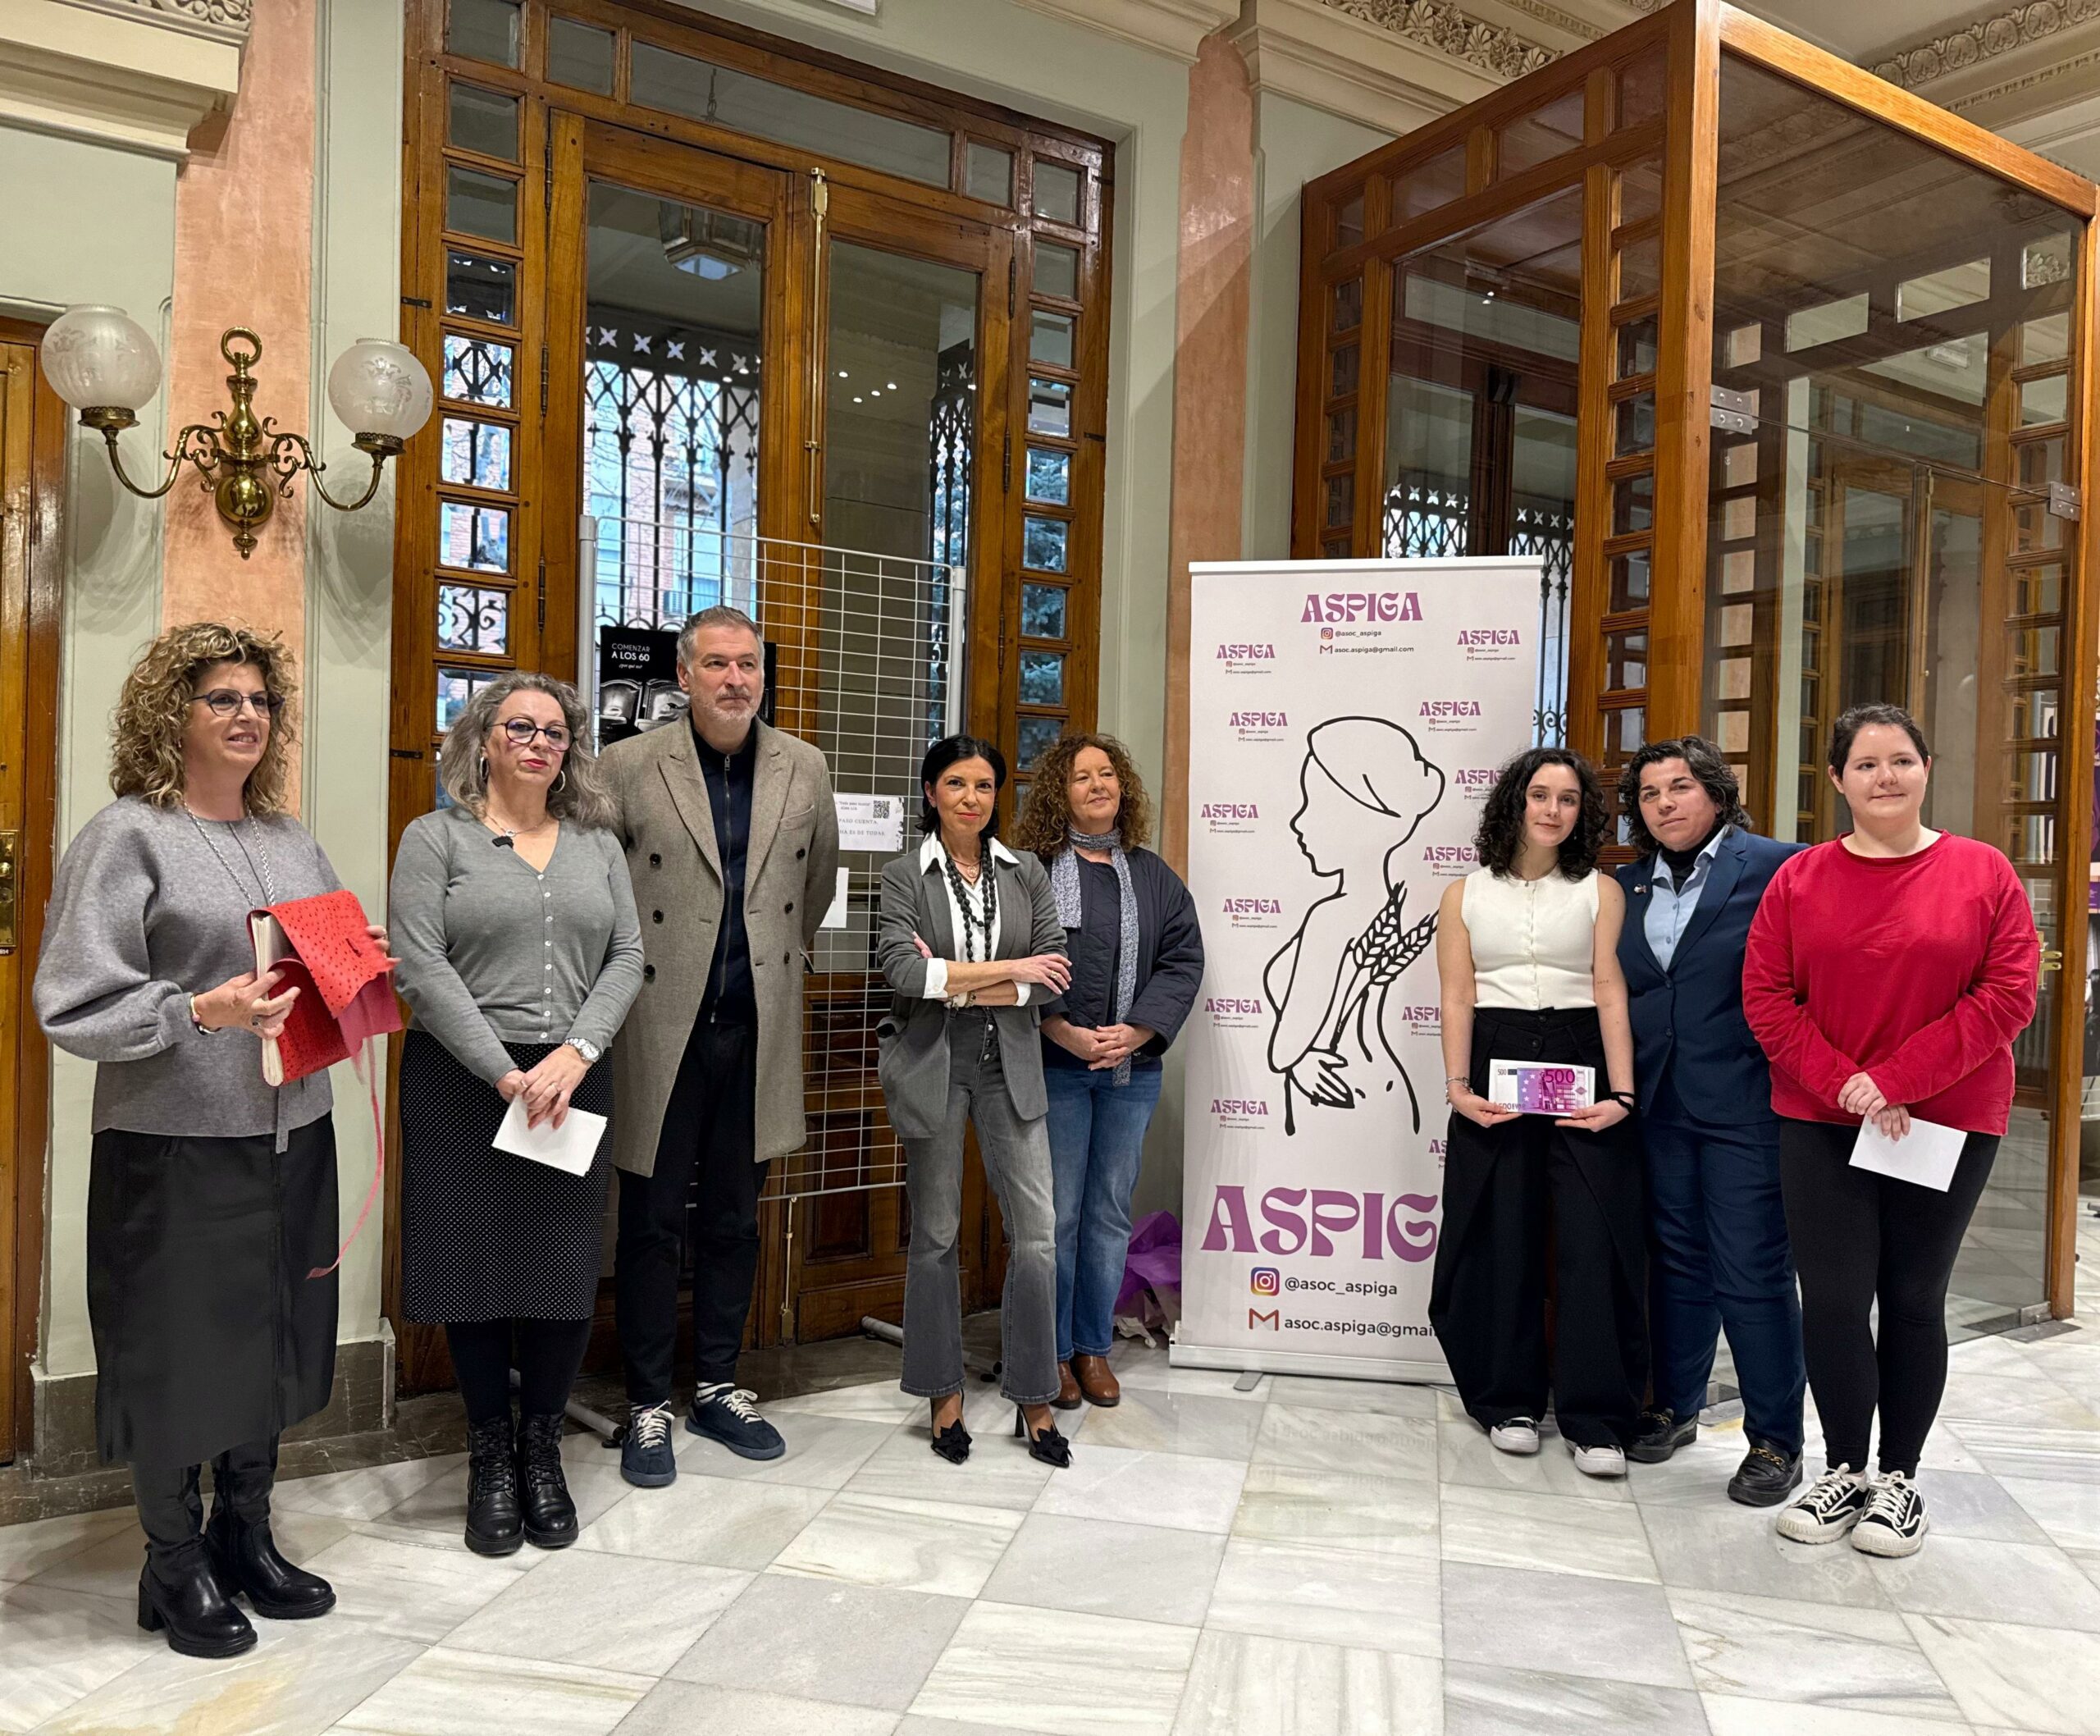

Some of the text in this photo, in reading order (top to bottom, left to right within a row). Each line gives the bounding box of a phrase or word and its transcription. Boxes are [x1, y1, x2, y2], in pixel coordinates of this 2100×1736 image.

[1300, 592, 1423, 623] ASPIGA
[1335, 630, 1381, 638] @asoc_aspiga
[1457, 629, 1521, 646] ASPIGA
[611, 643, 651, 652] COMENZAR
[1217, 644, 1276, 659] ASPIGA
[1335, 646, 1414, 654] asoc.aspiga@gmail.com
[611, 651, 651, 661] A LOS 60
[1418, 701, 1481, 716] ASPIGA
[1229, 712, 1289, 727] ASPIGA
[1201, 804, 1259, 819] ASPIGA
[1223, 898, 1281, 914] ASPIGA
[1204, 998, 1262, 1014] ASPIGA
[1401, 1007, 1441, 1021] ASPI
[1543, 1069, 1576, 1084] 500
[1211, 1099, 1269, 1115] ASPIGA
[1200, 1185, 1439, 1263] ASPIG
[1285, 1277, 1398, 1297] @asoc_aspiga
[1284, 1318, 1436, 1338] asoc.aspiga@gmai
